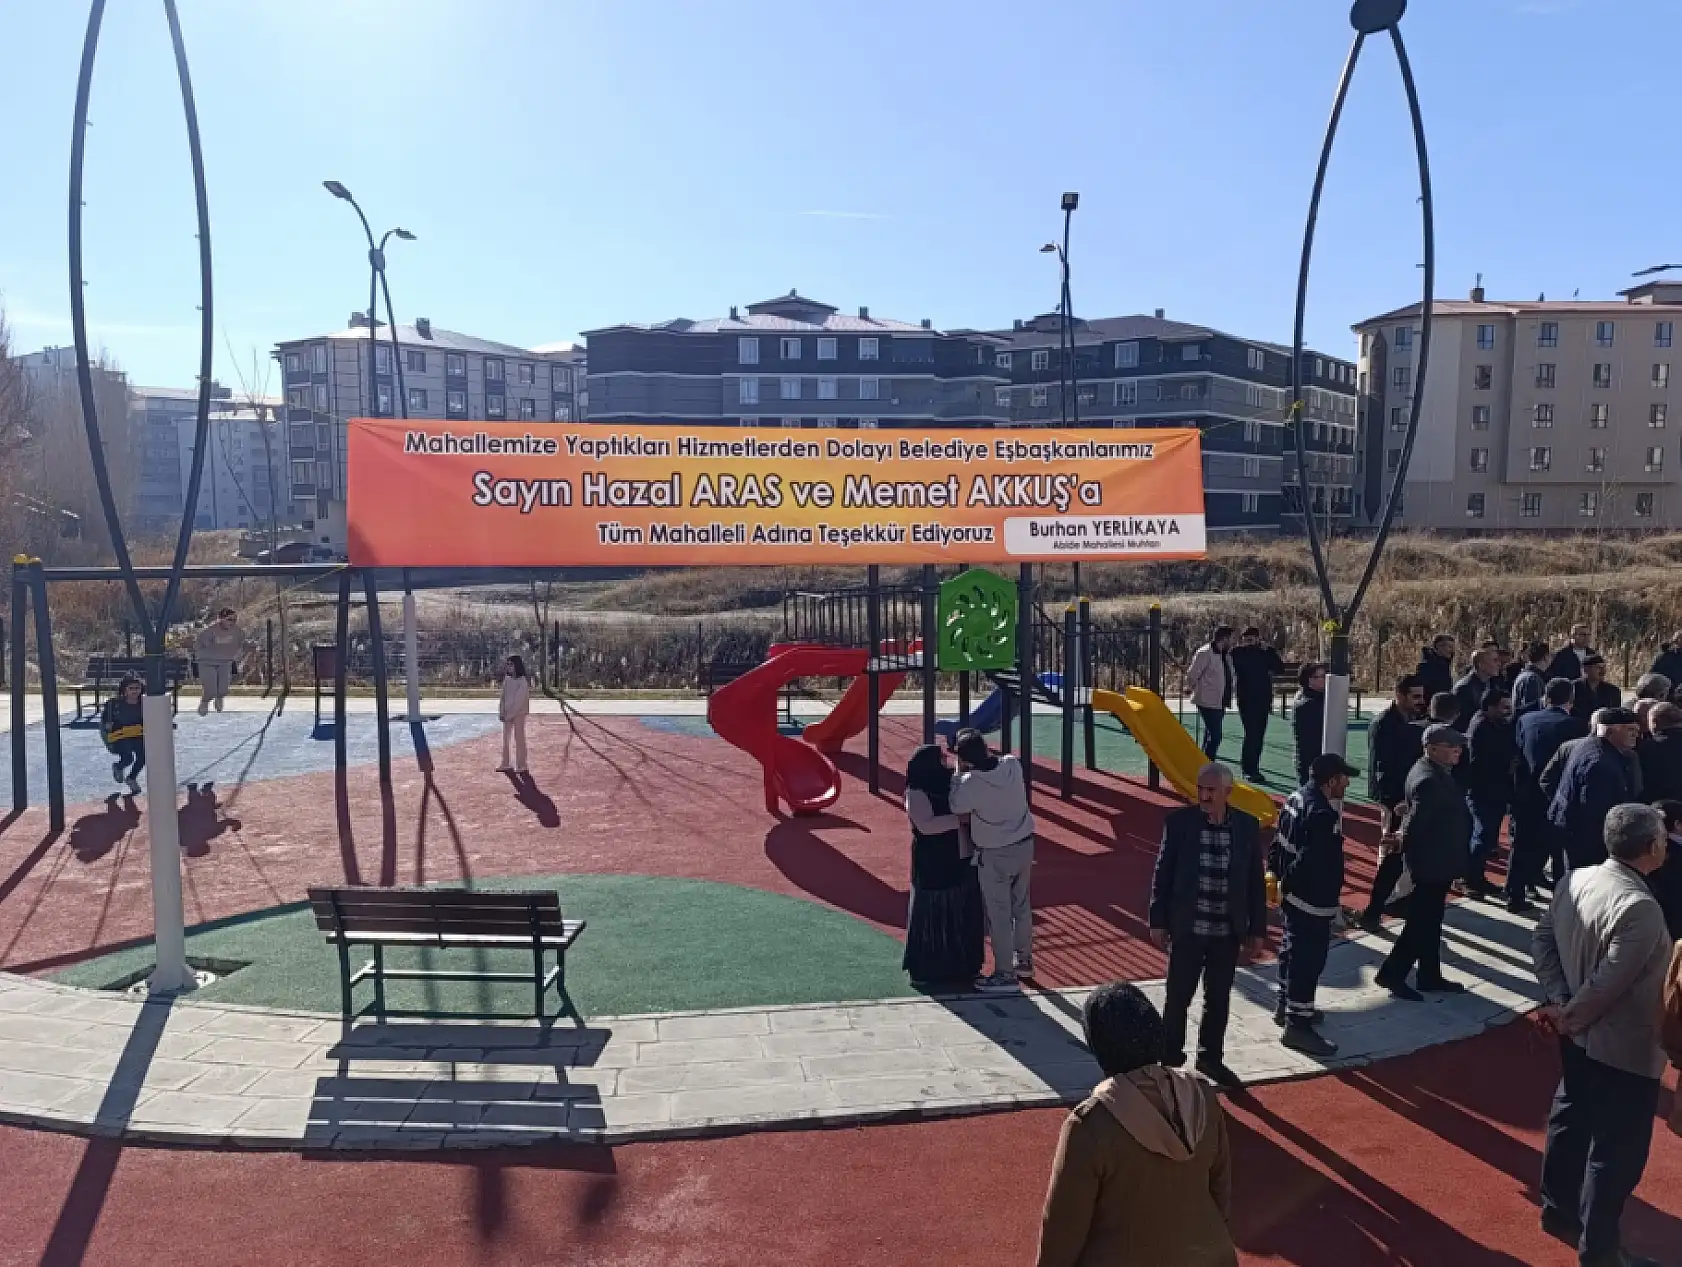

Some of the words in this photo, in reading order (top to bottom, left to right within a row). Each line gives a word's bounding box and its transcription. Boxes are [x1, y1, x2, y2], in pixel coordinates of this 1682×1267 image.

[405, 432, 558, 455] Mahallemize
[563, 434, 671, 460] Yaptıkları
[677, 436, 820, 459] Hizmetlerden
[825, 437, 893, 462] Dolayı
[899, 438, 989, 462] Belediye
[994, 438, 1155, 462] Eşbaşkanlarımız
[472, 470, 572, 514] Sayın
[582, 472, 681, 506] Hazal
[690, 473, 783, 508] ARAS
[789, 480, 834, 508] ve
[842, 474, 959, 508] Memet
[966, 473, 1103, 513] AKKUŞ'a
[598, 521, 644, 544] Tüm
[649, 522, 747, 545] Mahalleli
[751, 522, 812, 544] Adına
[817, 523, 906, 548] Teşekkür
[911, 522, 995, 548] Ediyoruz
[1029, 520, 1087, 537] Burhan
[1092, 516, 1180, 537] YERLİKAYA
